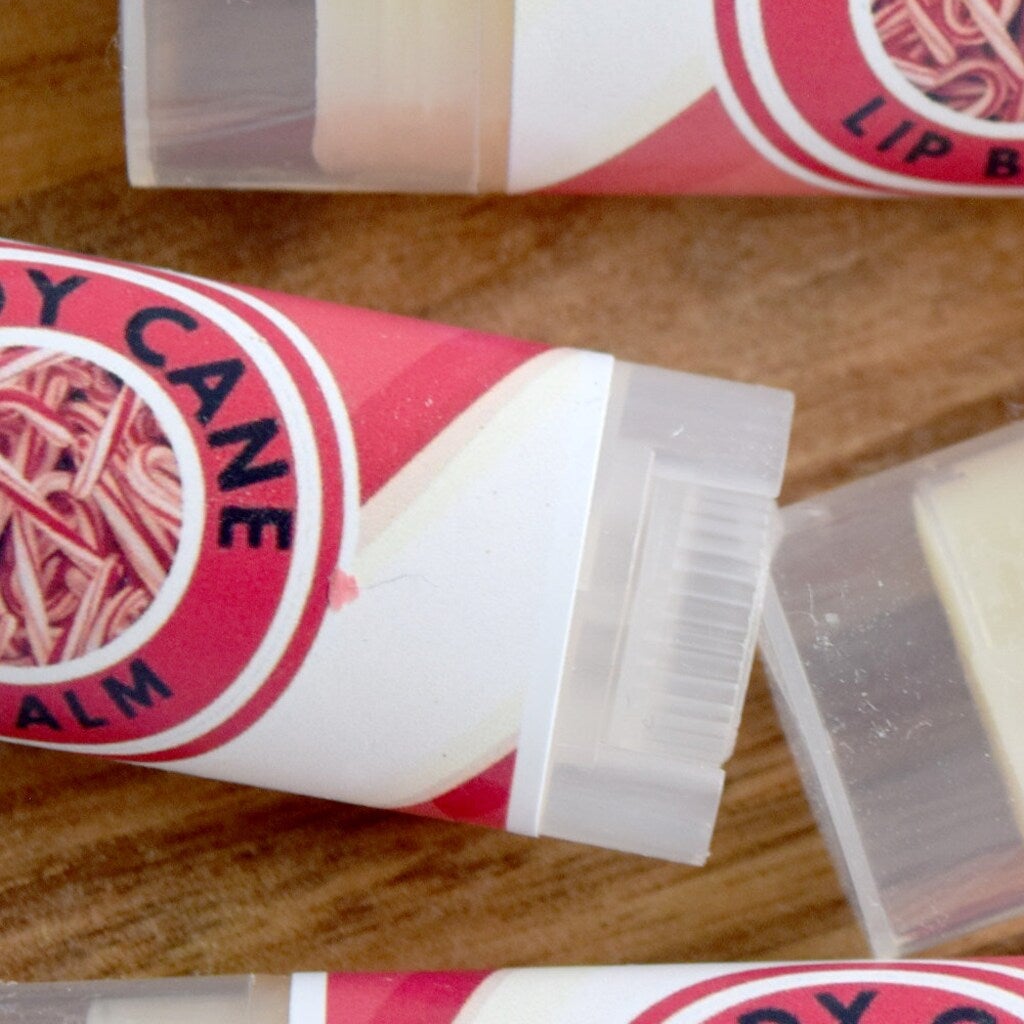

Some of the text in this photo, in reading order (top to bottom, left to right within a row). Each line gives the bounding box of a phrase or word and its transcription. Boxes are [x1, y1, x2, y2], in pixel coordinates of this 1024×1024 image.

[842, 96, 952, 164] LIP
[125, 306, 294, 550] CANE
[16, 658, 173, 730] ALM
